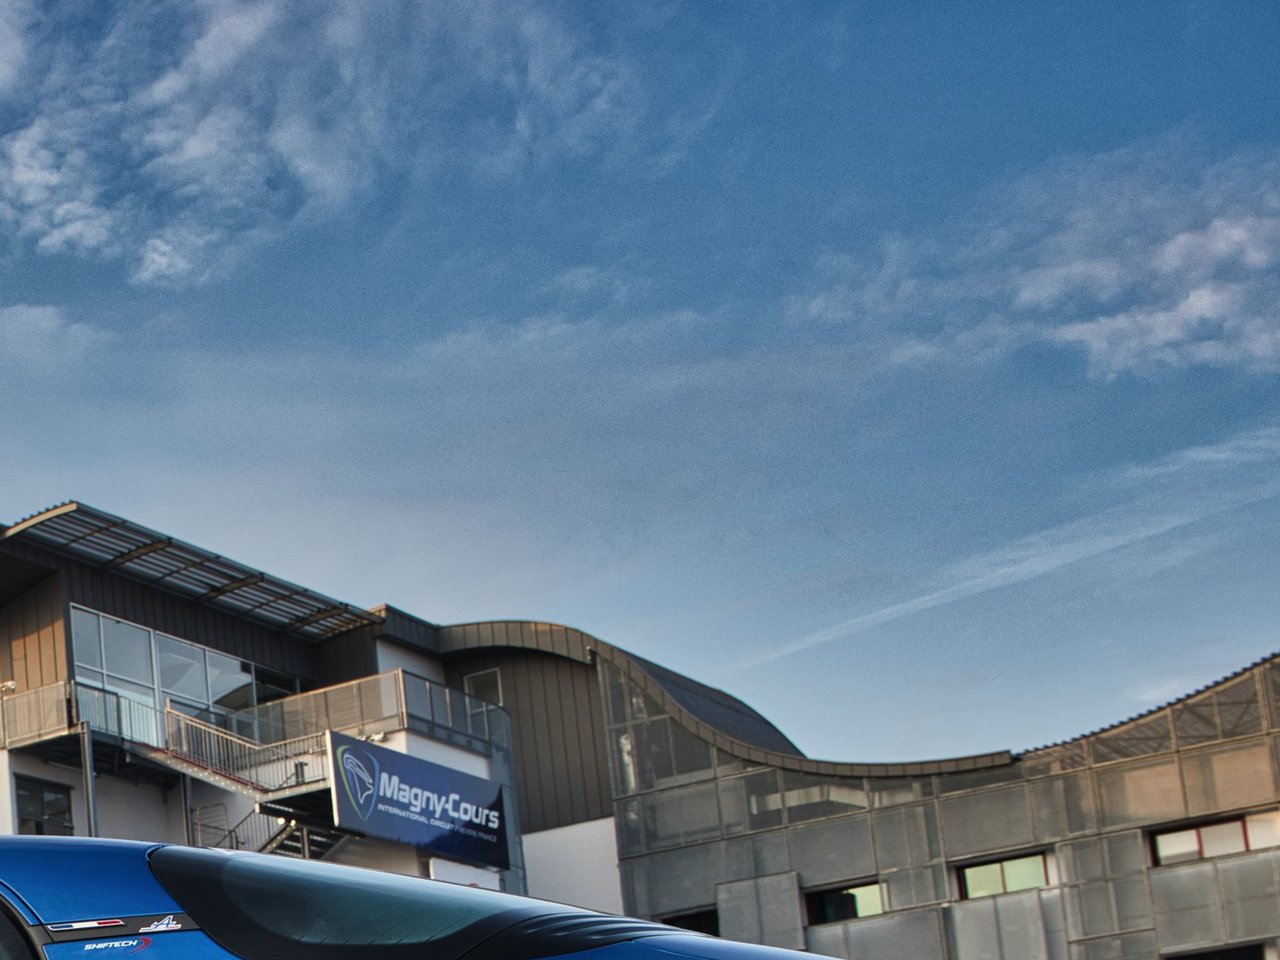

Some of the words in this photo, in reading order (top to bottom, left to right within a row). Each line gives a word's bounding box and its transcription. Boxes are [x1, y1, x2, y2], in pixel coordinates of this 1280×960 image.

[379, 772, 499, 829] Magny-Cours
[377, 804, 428, 824] INTERNATIONAL
[430, 818, 454, 830] CIRCUIT
[83, 940, 138, 951] SHIFTECH
